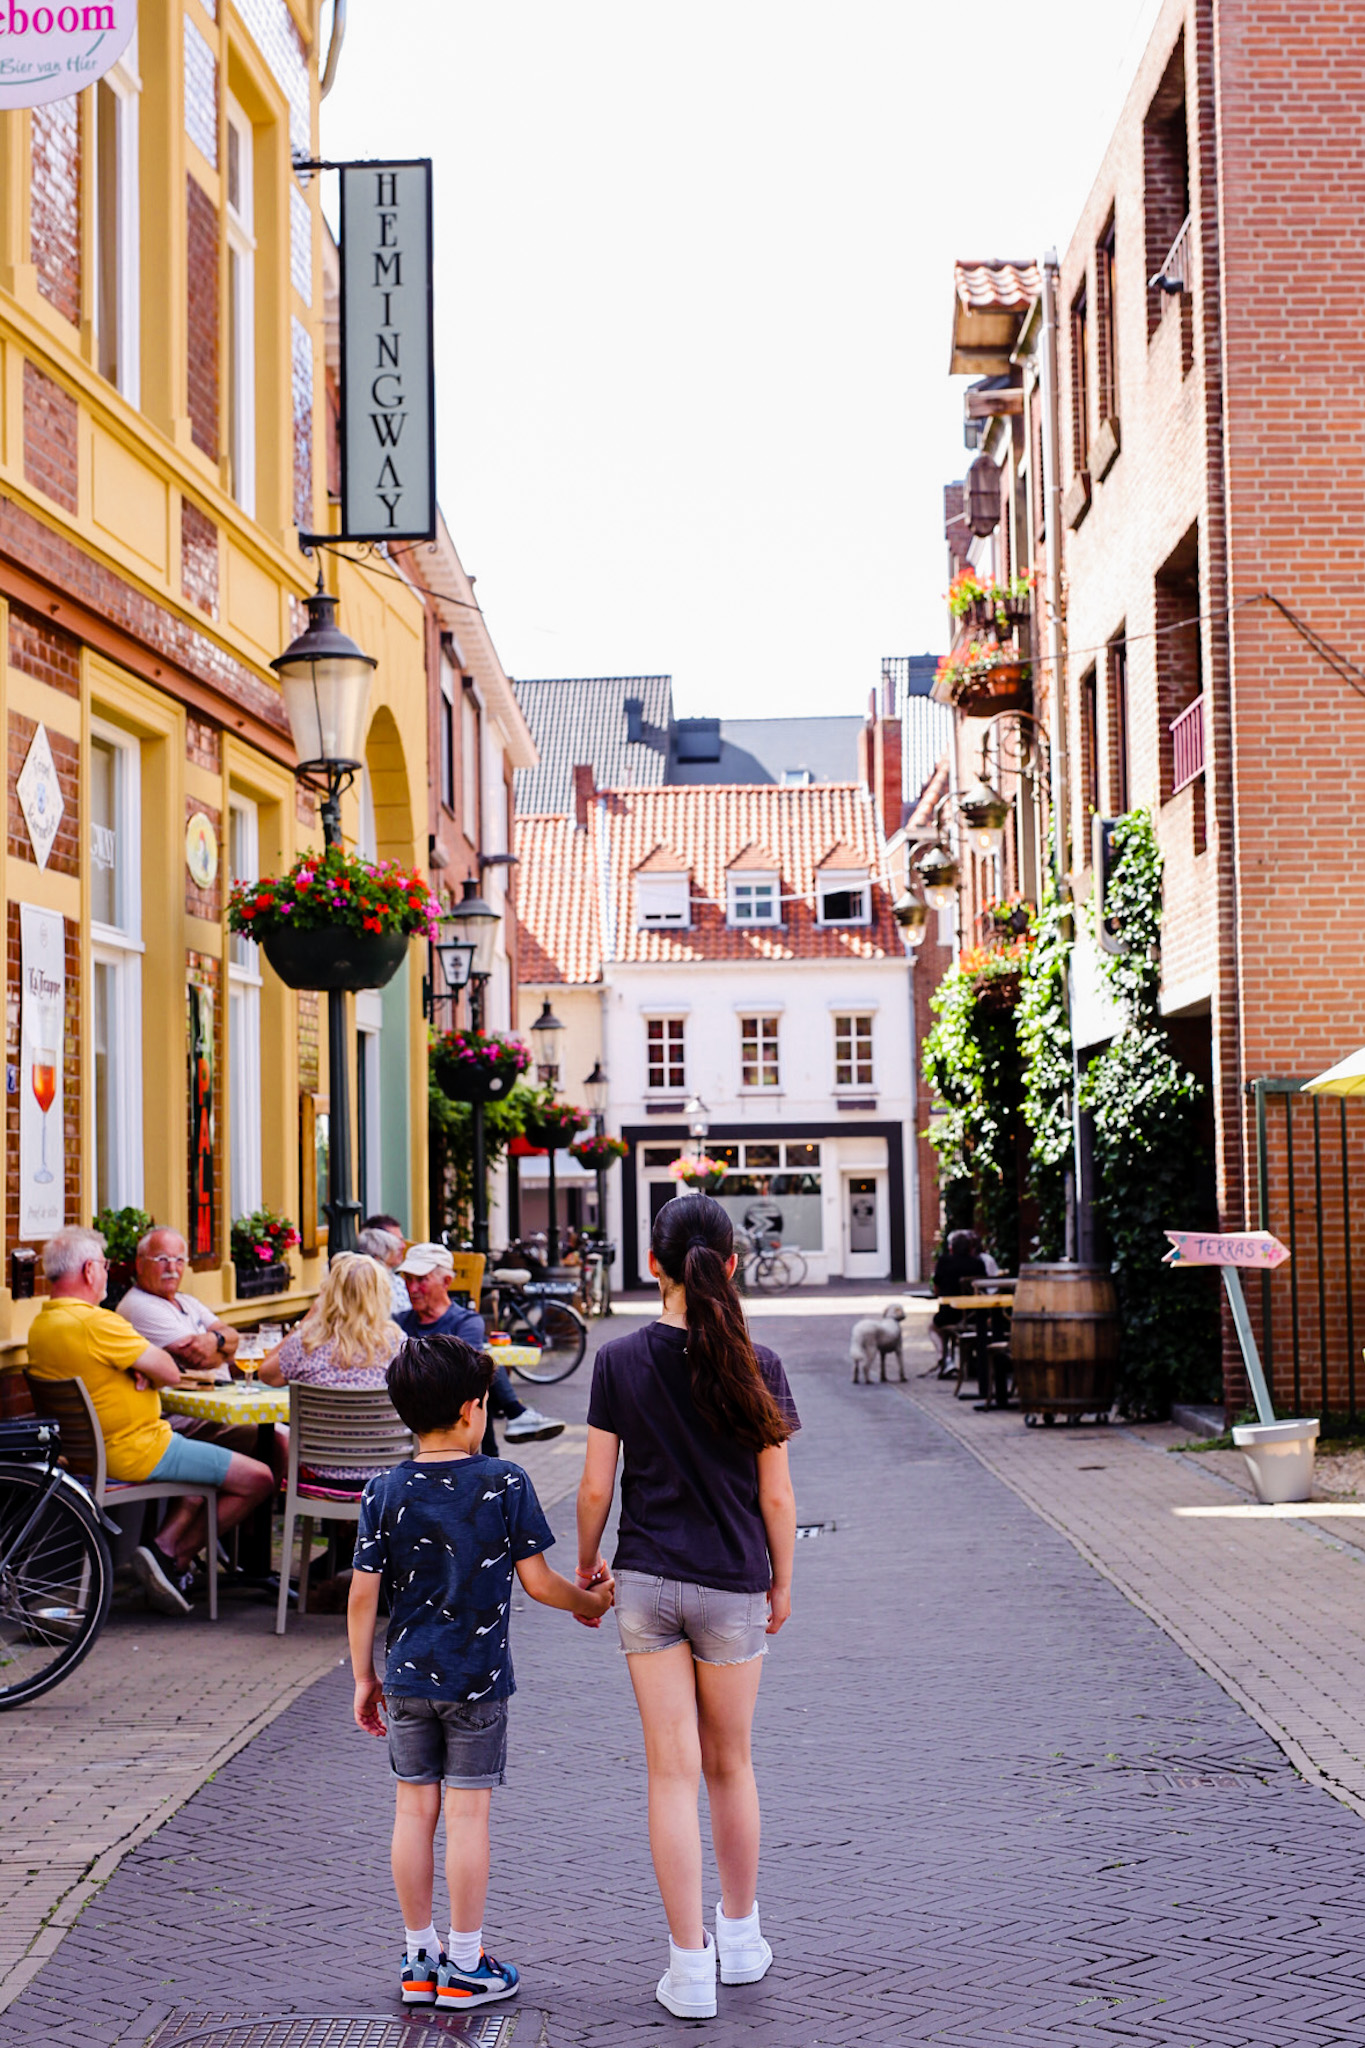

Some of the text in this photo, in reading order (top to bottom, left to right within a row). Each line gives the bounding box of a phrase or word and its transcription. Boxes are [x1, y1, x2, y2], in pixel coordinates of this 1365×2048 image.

[0, 0, 116, 35] boom
[0, 55, 97, 75] Bier van Hier
[369, 172, 409, 529] HEMINGWAY
[197, 1057, 211, 1253] PALM
[1194, 1239, 1255, 1261] TERRAS
